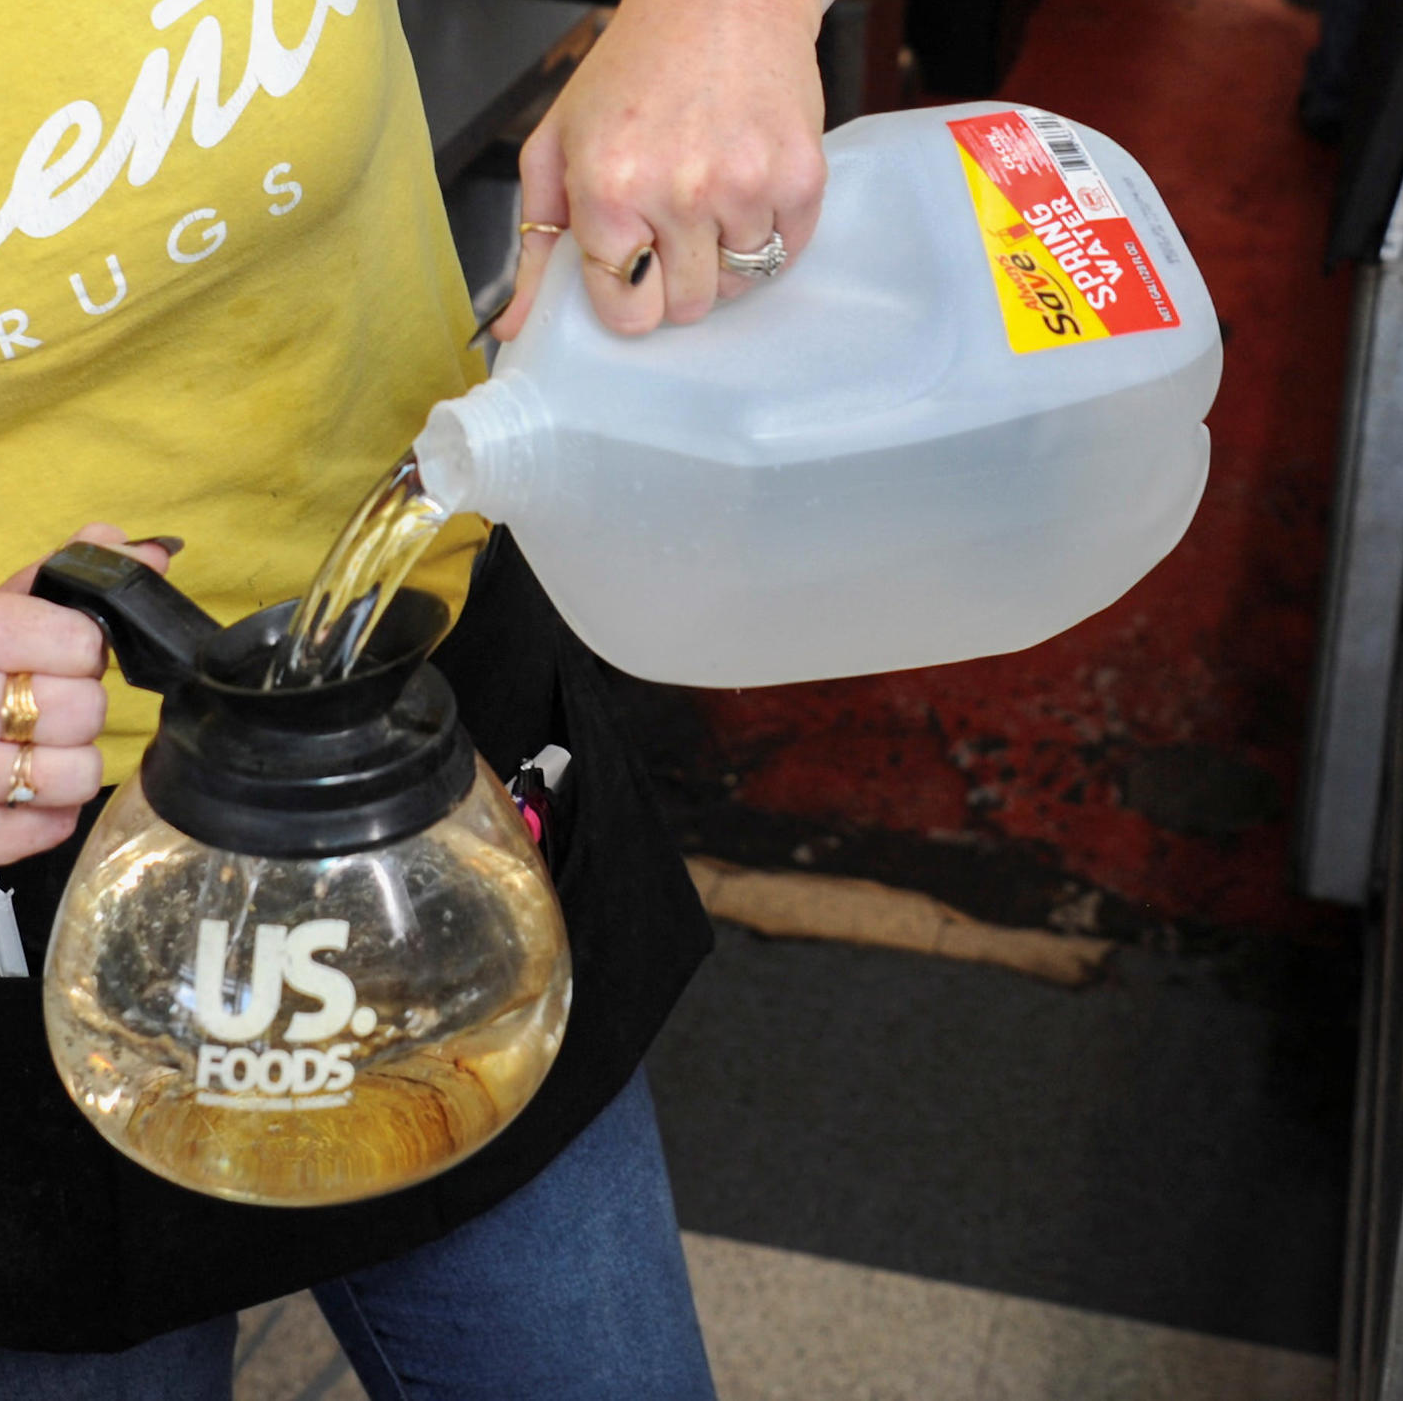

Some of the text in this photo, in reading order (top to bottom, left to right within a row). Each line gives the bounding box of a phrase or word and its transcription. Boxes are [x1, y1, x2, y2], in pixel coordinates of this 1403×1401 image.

[1022, 203, 1118, 310] SPRING
[1049, 195, 1124, 285] WATER
[196, 1042, 356, 1094] FOODS
